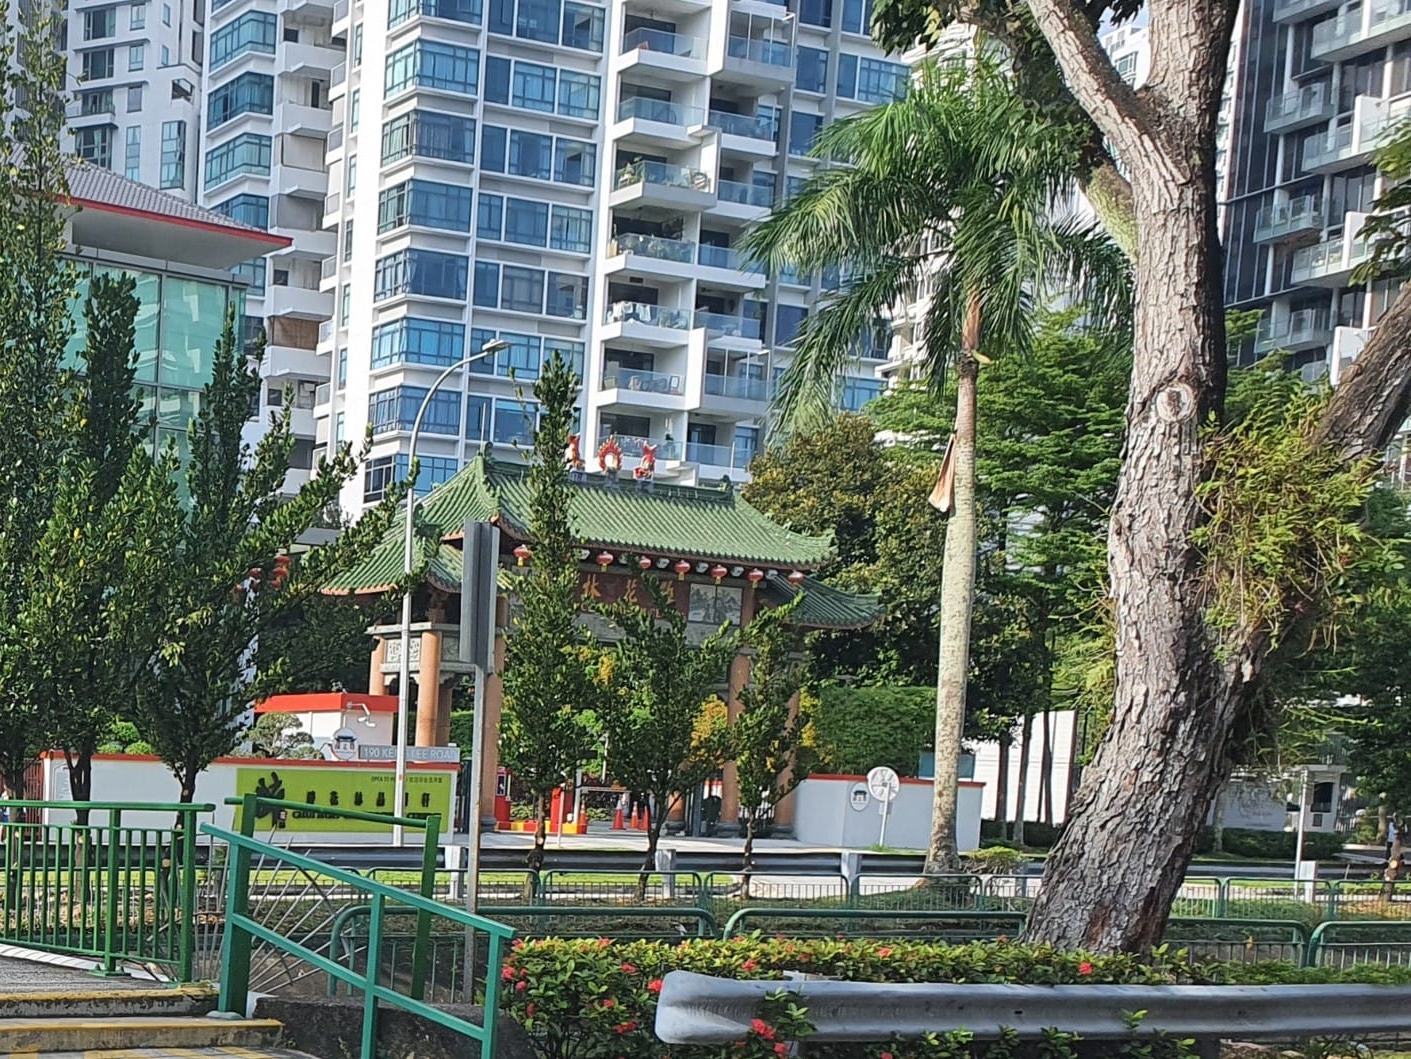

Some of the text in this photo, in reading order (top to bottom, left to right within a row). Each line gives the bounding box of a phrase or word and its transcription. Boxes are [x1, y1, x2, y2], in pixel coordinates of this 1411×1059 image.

[364, 747, 380, 758] 190
[412, 749, 427, 759] LEE
[430, 749, 457, 760] ROAD
